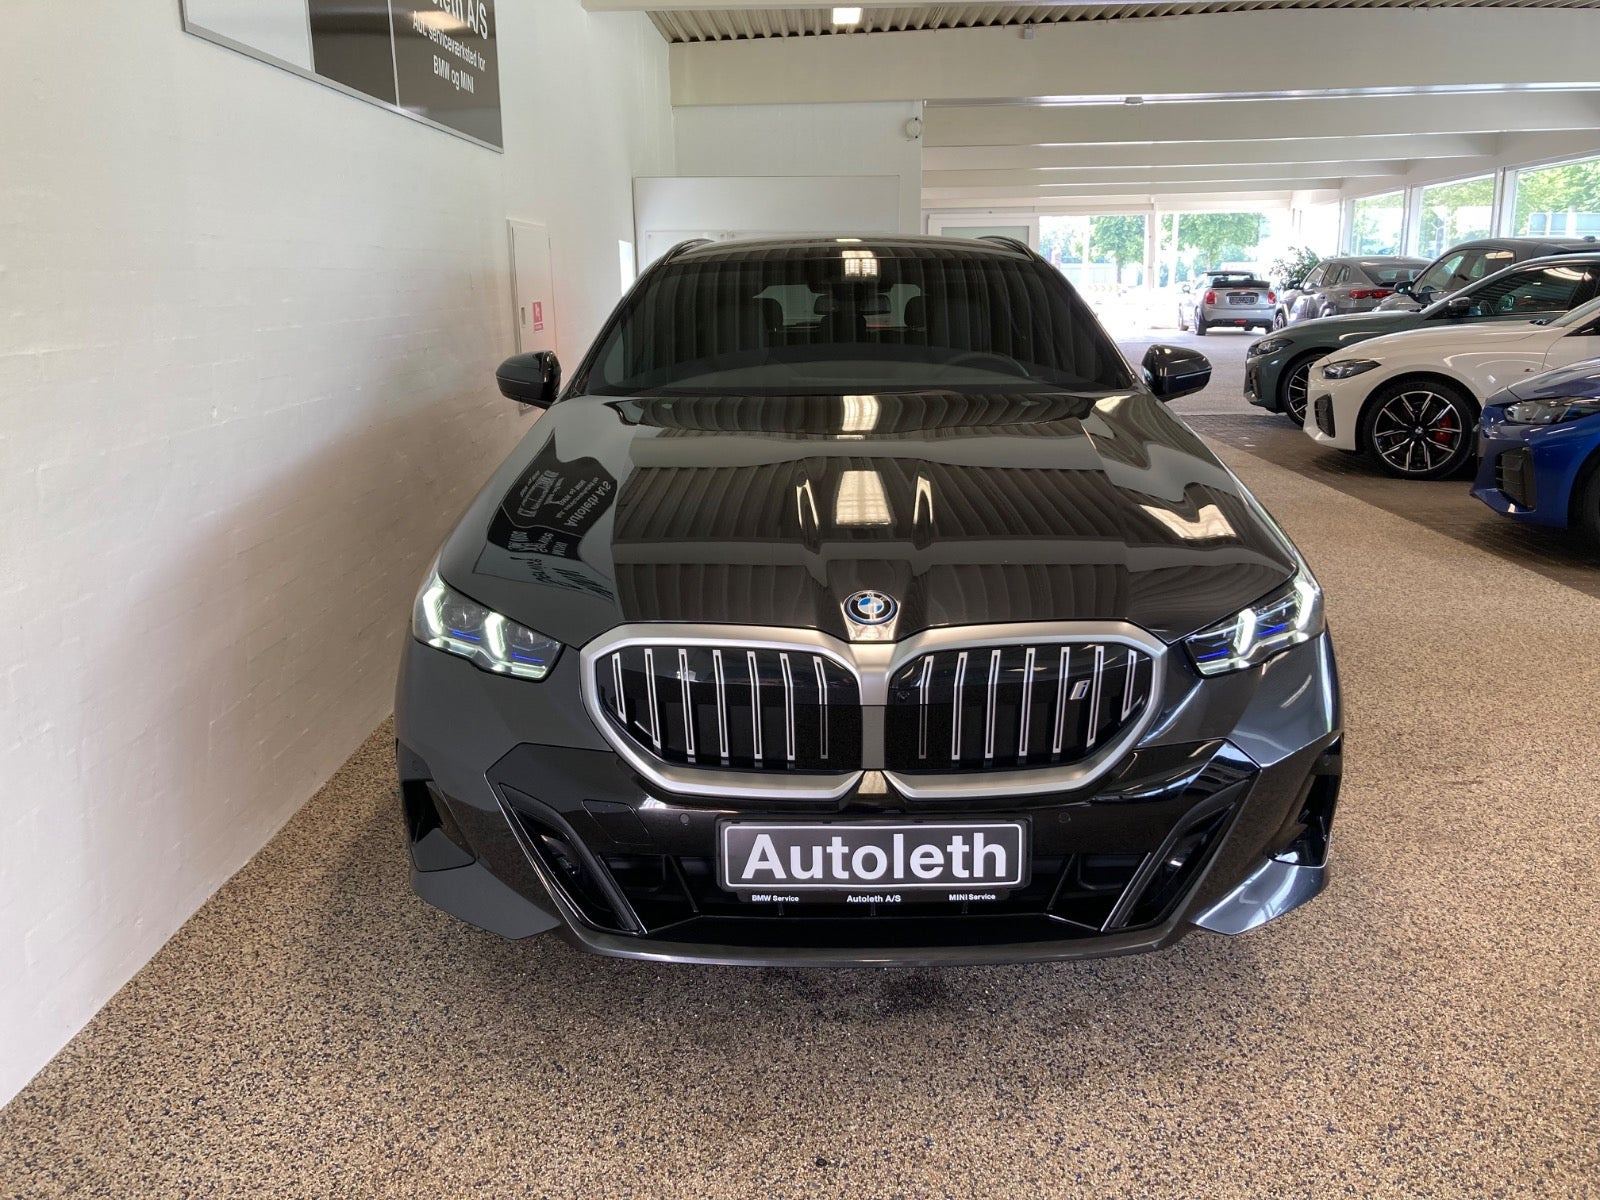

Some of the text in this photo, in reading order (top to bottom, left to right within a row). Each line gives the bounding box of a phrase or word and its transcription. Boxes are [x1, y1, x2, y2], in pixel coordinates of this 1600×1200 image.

[467, 0, 488, 39] A/S
[433, 54, 474, 94] BMW og MINI
[741, 832, 1006, 880] Autoleth
[751, 894, 799, 902] BMW Service
[846, 894, 901, 903] Autoleth A/S
[949, 893, 996, 901] MINI Service
